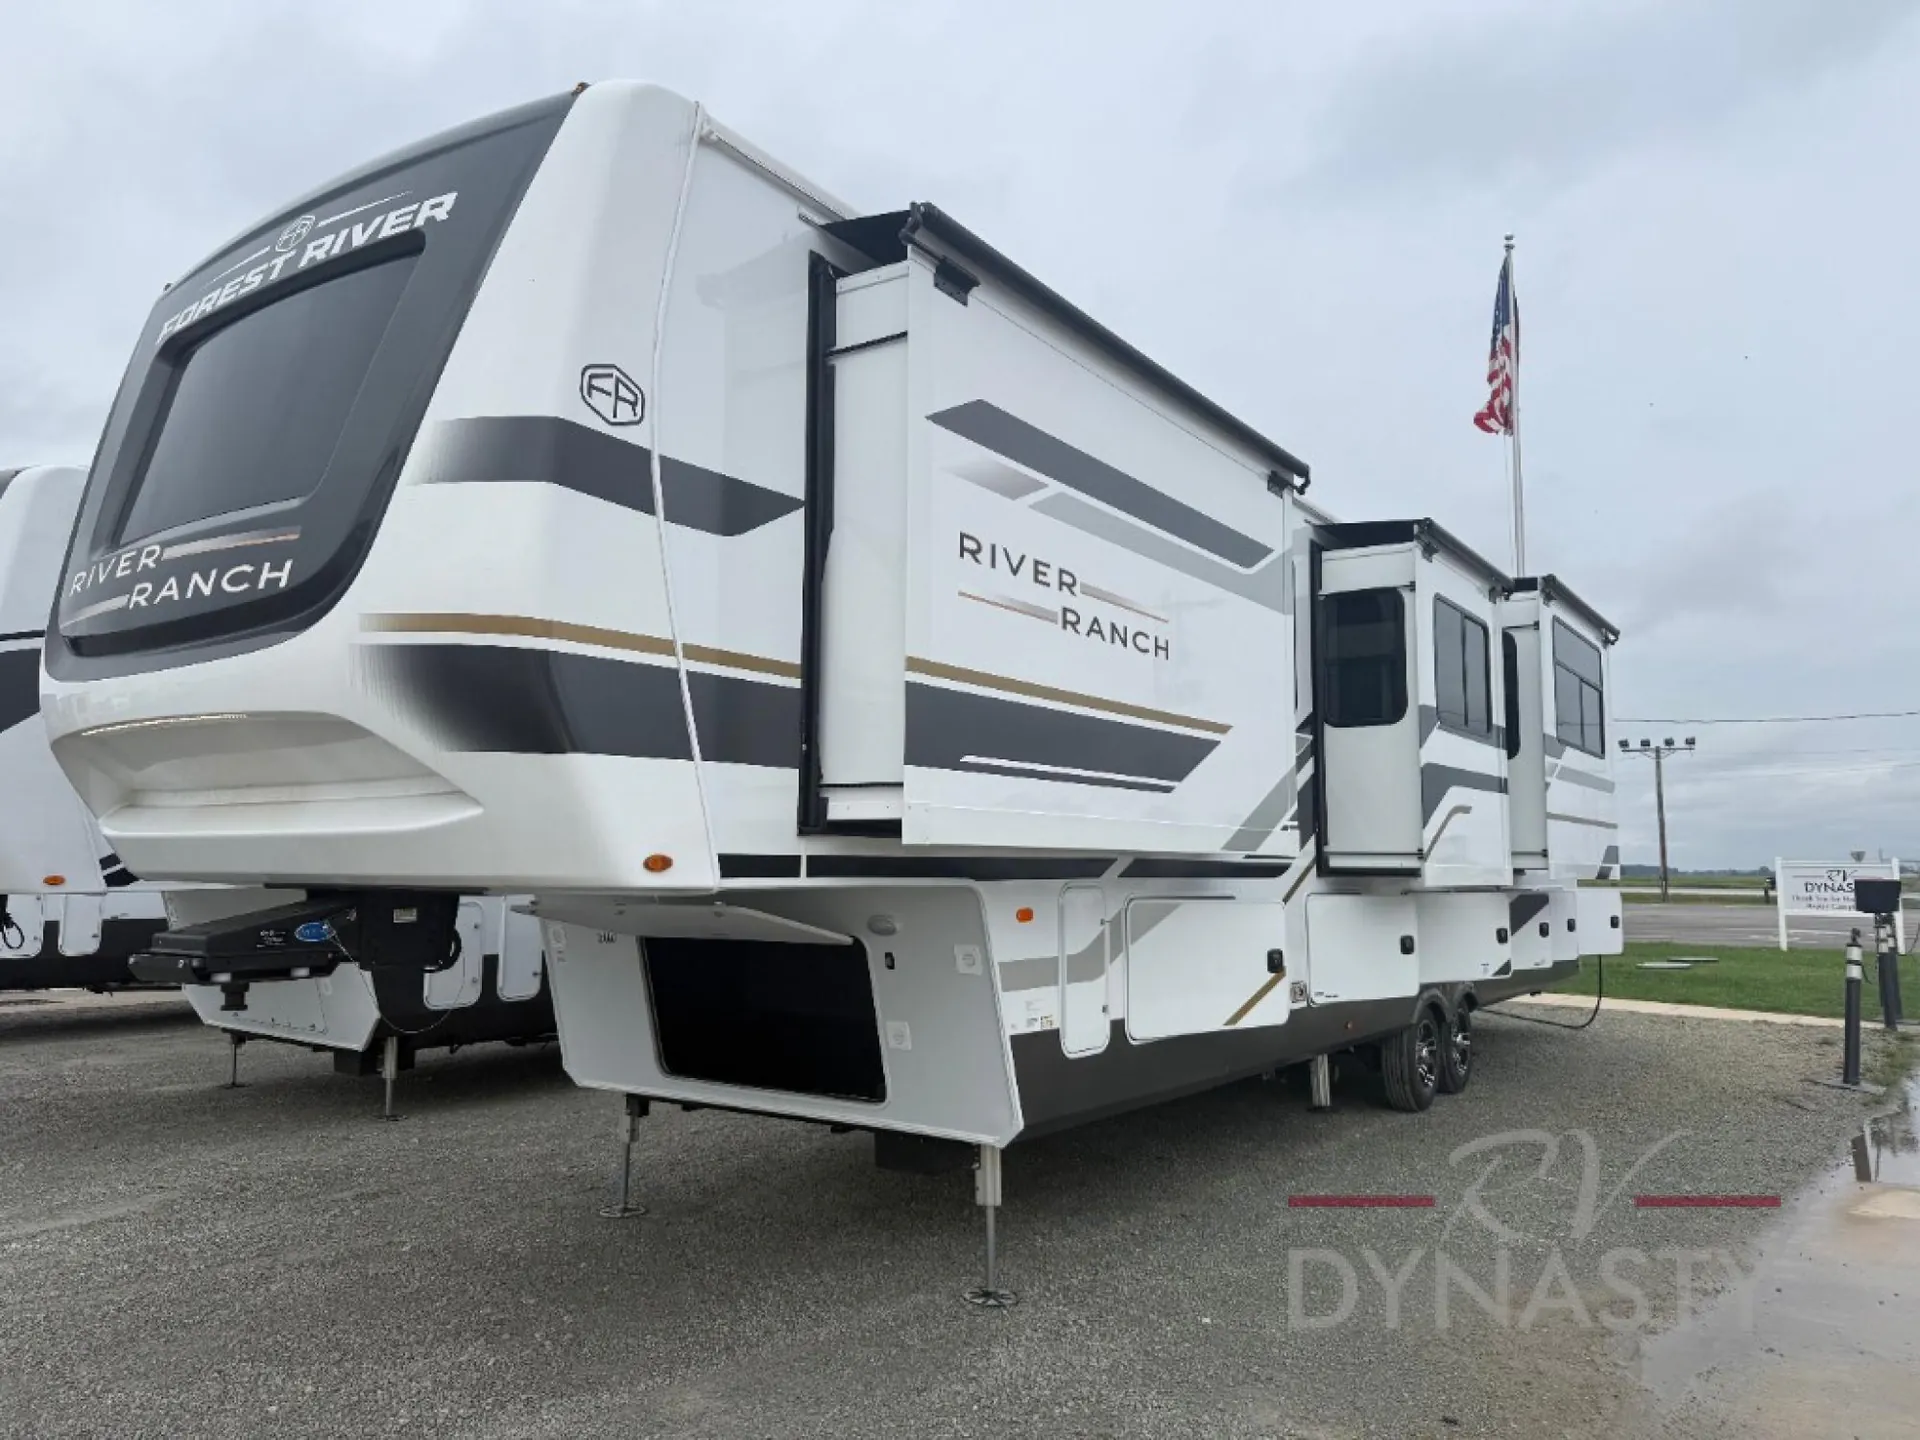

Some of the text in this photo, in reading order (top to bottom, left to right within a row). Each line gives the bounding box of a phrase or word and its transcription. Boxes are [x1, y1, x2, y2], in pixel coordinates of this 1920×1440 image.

[155, 191, 458, 344] FOREST RIVER
[69, 544, 162, 597] RIVER
[129, 558, 293, 610] RANCH
[959, 530, 1079, 597] RIVER
[1061, 606, 1170, 660] RANCH
[1804, 882, 1855, 893] DYNAS
